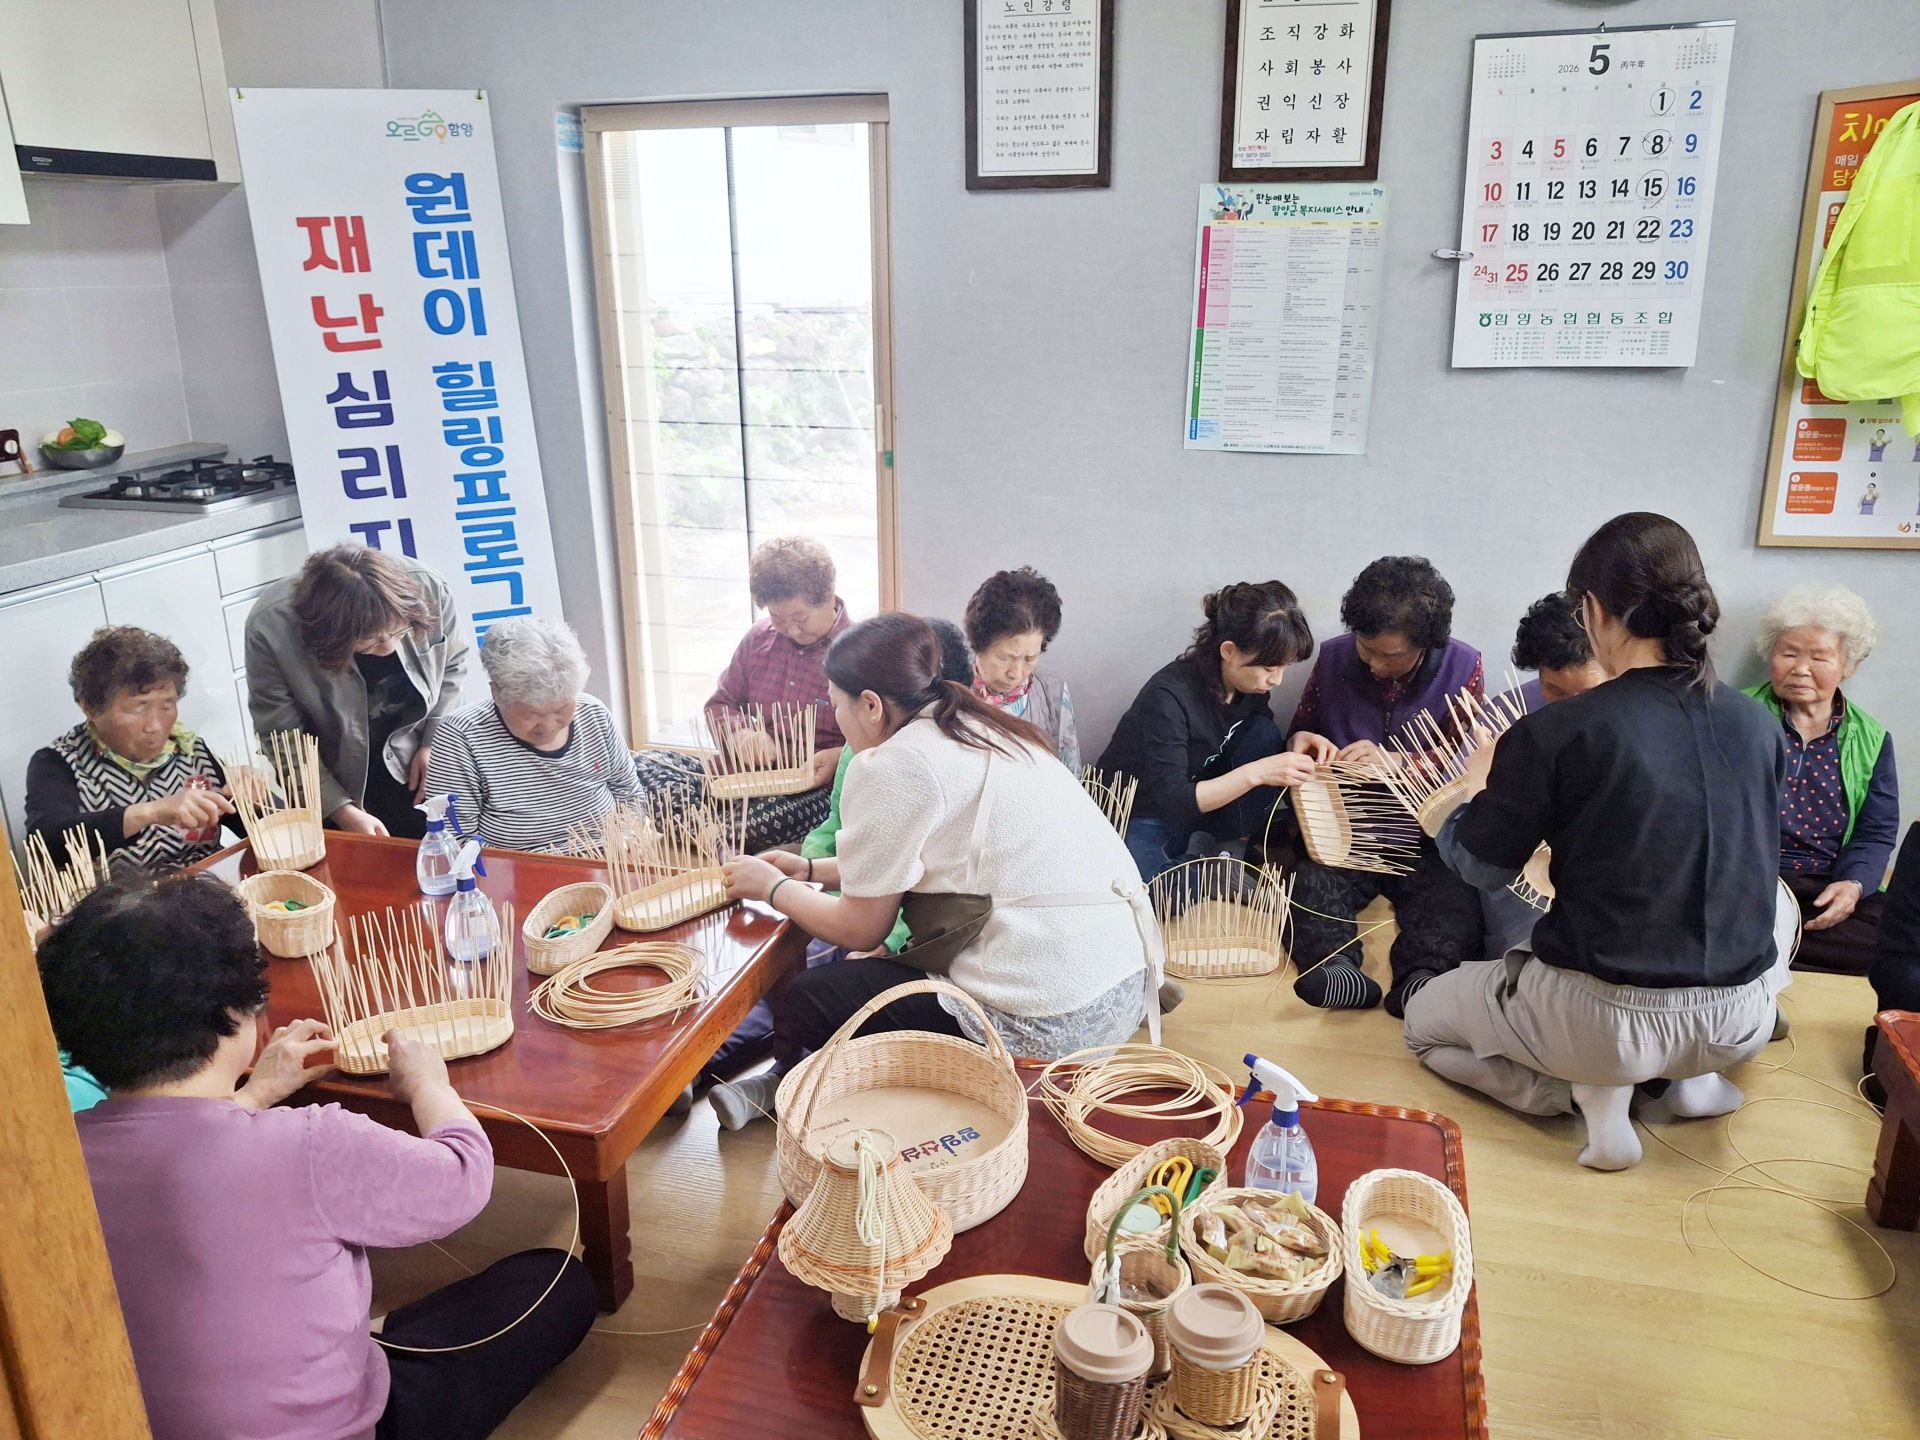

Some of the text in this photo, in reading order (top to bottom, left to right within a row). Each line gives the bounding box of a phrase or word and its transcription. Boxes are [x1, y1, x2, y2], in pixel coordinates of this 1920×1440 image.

[1558, 44, 1645, 75] 2026 5 丙午年
[1659, 90, 1702, 110] 1 2
[1491, 134, 1697, 159] 3 4 5 6 7 8 9
[1835, 153, 1858, 166] 매일
[1256, 192, 1300, 205] 한눈에 보는
[1485, 177, 1696, 201] 10 11 12 13 14 15 16
[1272, 205, 1364, 217] 함양군 복지서비스 안내
[1483, 219, 1693, 242] 17 18 19 20 21 22 23
[1474, 261, 1688, 282] 24 31 25 26 27 28 29 30
[404, 172, 532, 649] 원데이 힐링프로그
